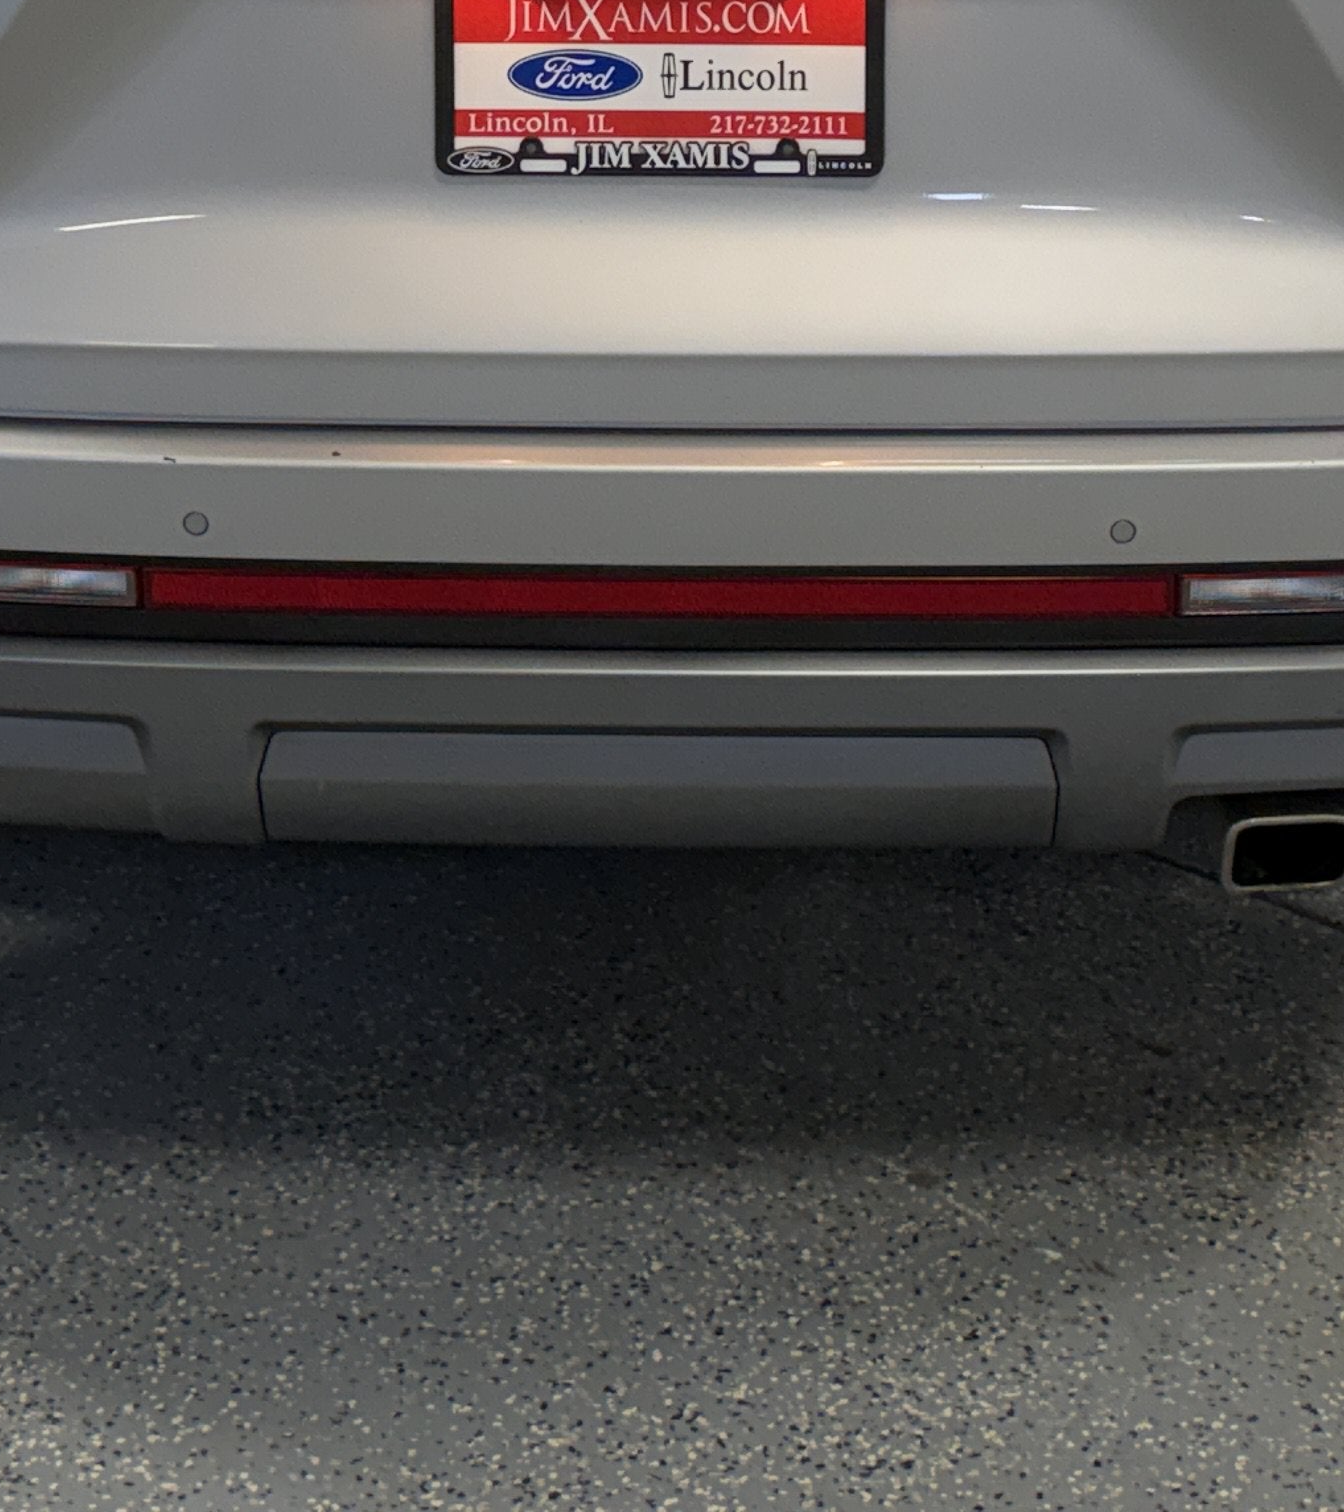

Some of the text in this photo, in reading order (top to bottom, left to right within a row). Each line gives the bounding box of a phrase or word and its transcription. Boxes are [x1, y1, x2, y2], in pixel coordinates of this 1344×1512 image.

[535, 56, 614, 91] Ford
[680, 60, 808, 90] Lincoln
[468, 112, 614, 135] Lincoln, IL
[710, 115, 847, 134] 217-732-2111
[459, 152, 501, 169] Ford
[571, 142, 750, 174] JIM XAMIS
